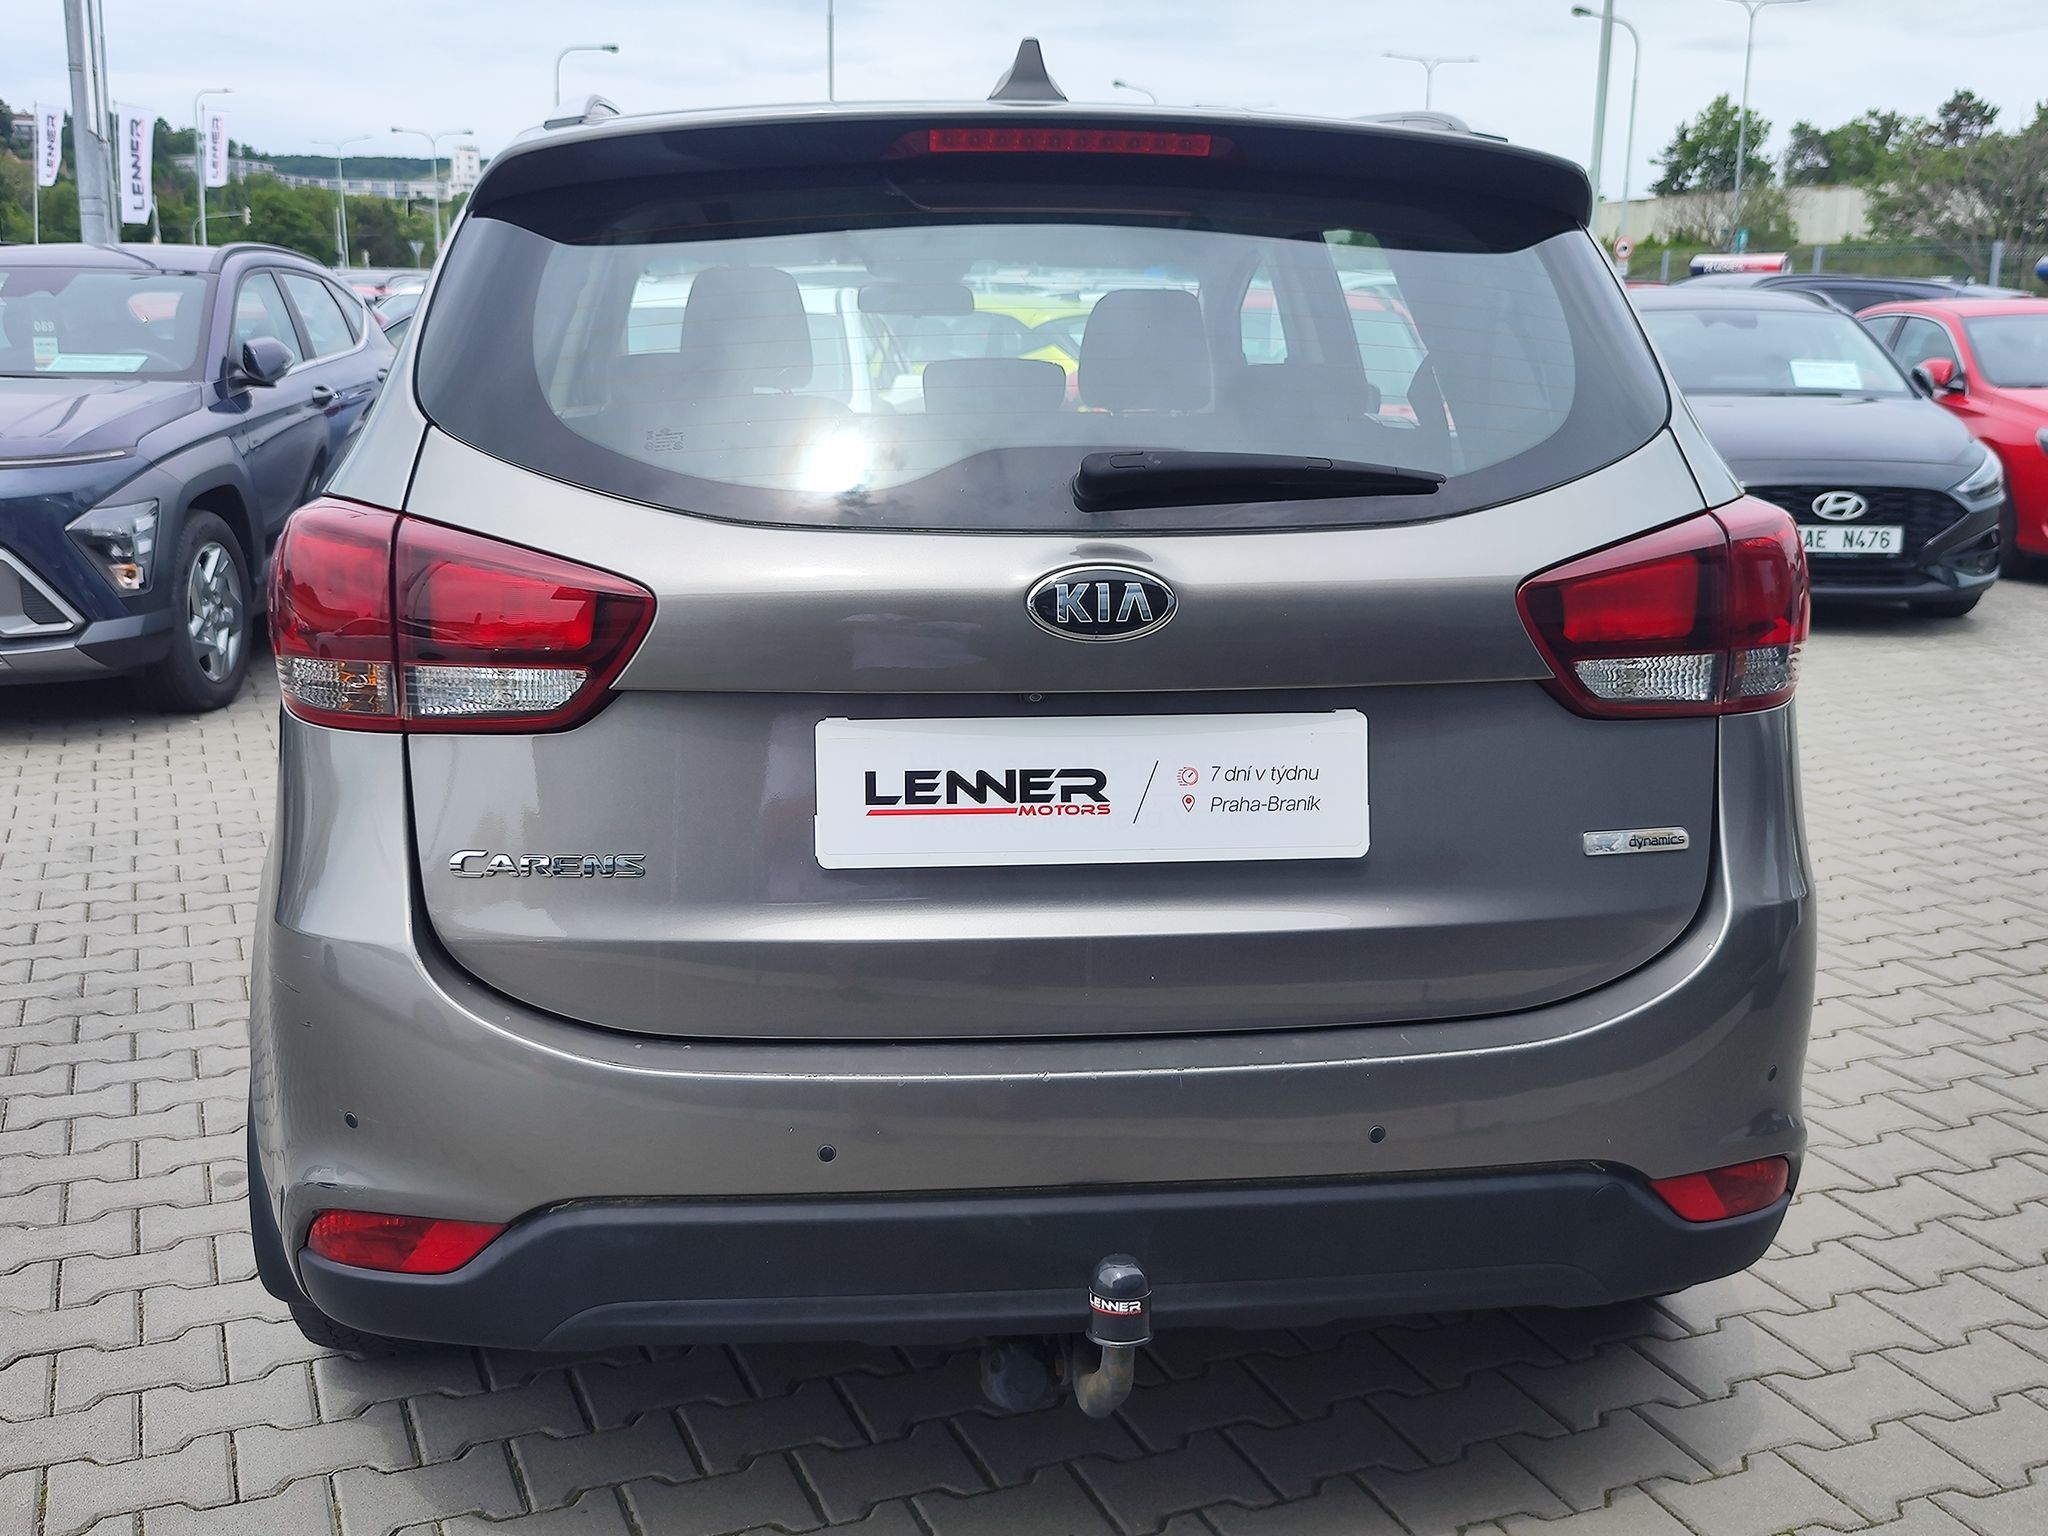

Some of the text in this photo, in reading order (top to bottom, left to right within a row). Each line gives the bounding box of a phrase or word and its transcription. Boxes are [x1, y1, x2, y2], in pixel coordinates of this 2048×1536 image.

[130, 118, 146, 211] LENNER
[1798, 529, 1890, 549] AE N476
[1055, 582, 1153, 623] KIA
[1211, 765, 1319, 785] 7 dní v týdnu
[865, 768, 1111, 805] LENNER
[1018, 803, 1111, 817] MOTORS
[1210, 795, 1321, 813] Praha-Braník
[1628, 834, 1685, 850] dynamics
[449, 849, 646, 878] CARENS
[1089, 1292, 1142, 1313] LENNER
